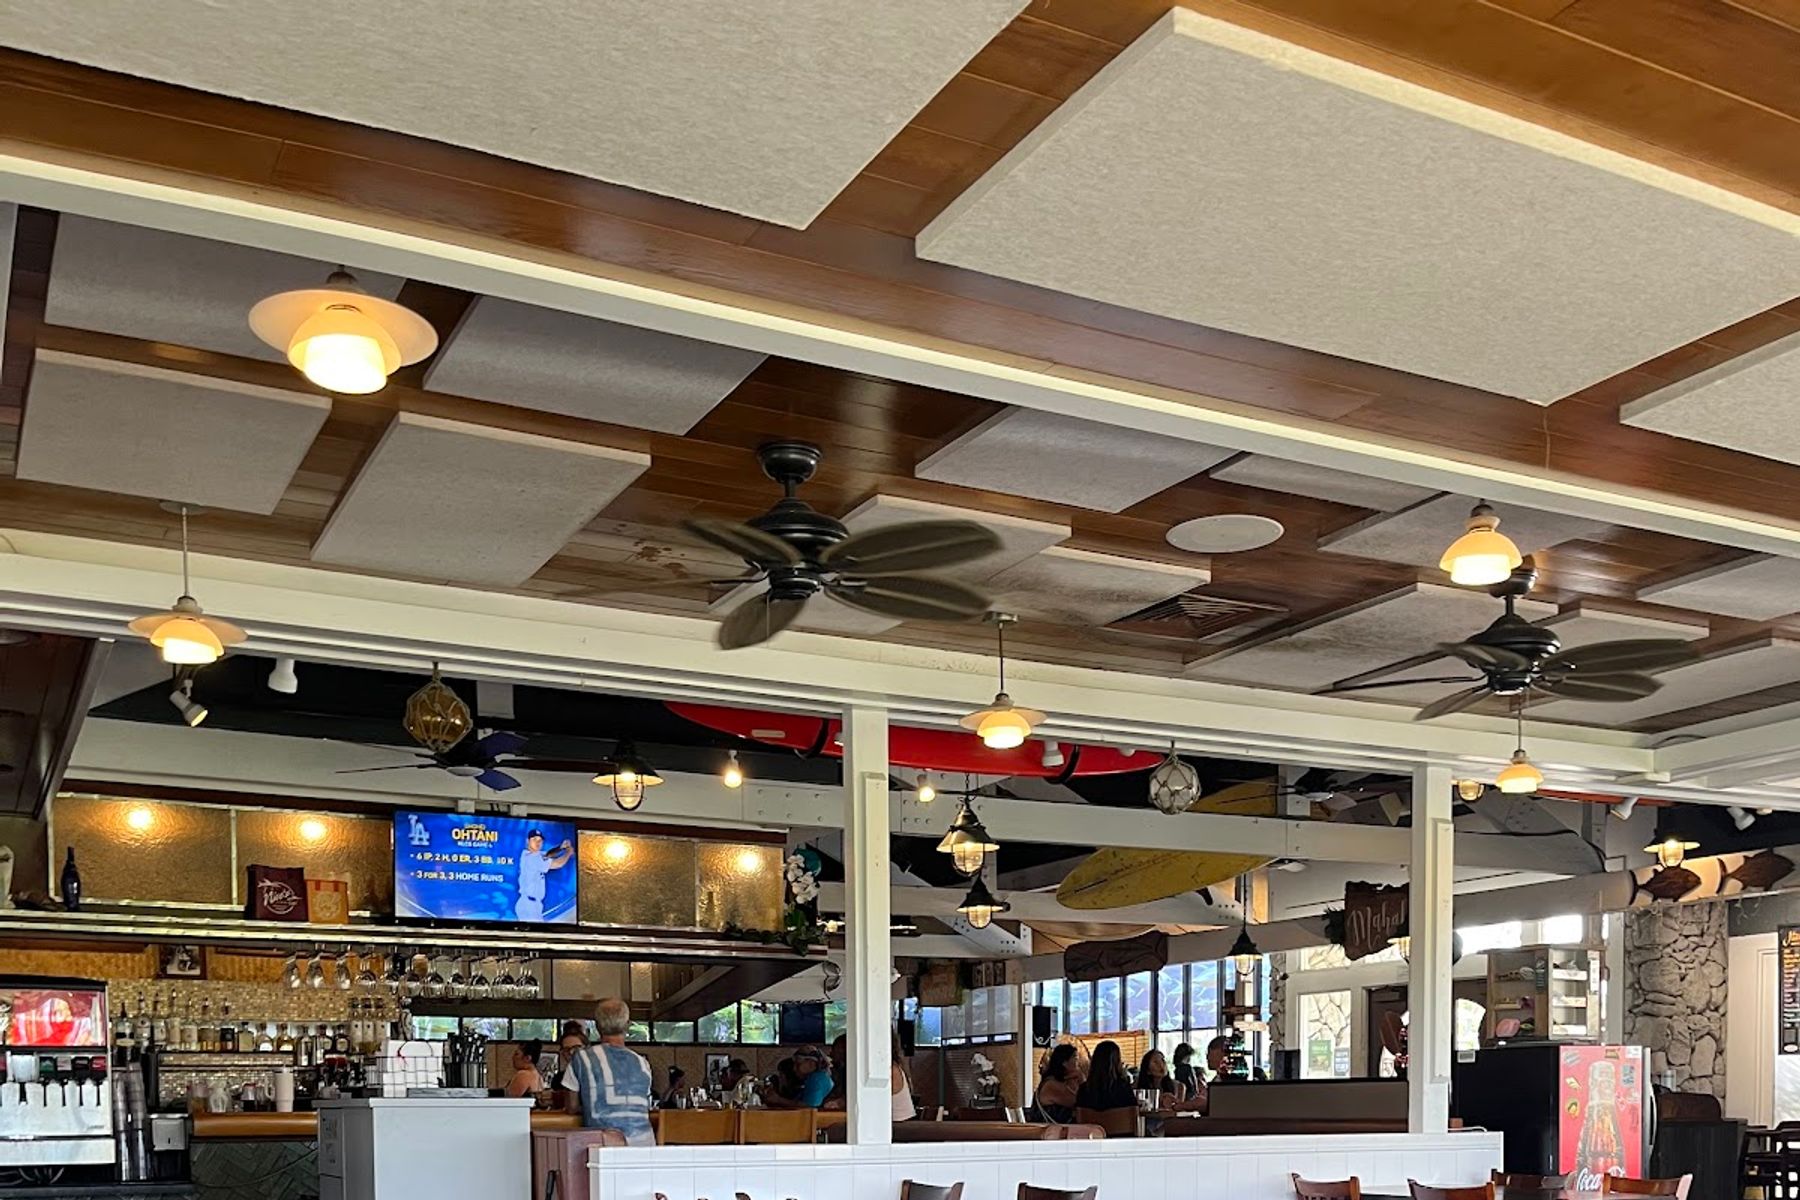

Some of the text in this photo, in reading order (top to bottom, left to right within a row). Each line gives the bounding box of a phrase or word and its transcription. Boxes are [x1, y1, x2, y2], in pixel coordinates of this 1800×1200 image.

[408, 814, 430, 845] LA
[452, 829, 498, 842] OHTANI
[434, 853, 441, 861] 2
[416, 871, 423, 879] 3
[448, 872, 455, 880] 3
[455, 872, 480, 882] HOME
[481, 873, 504, 883] RUNS
[1347, 900, 1405, 952] Mahal
